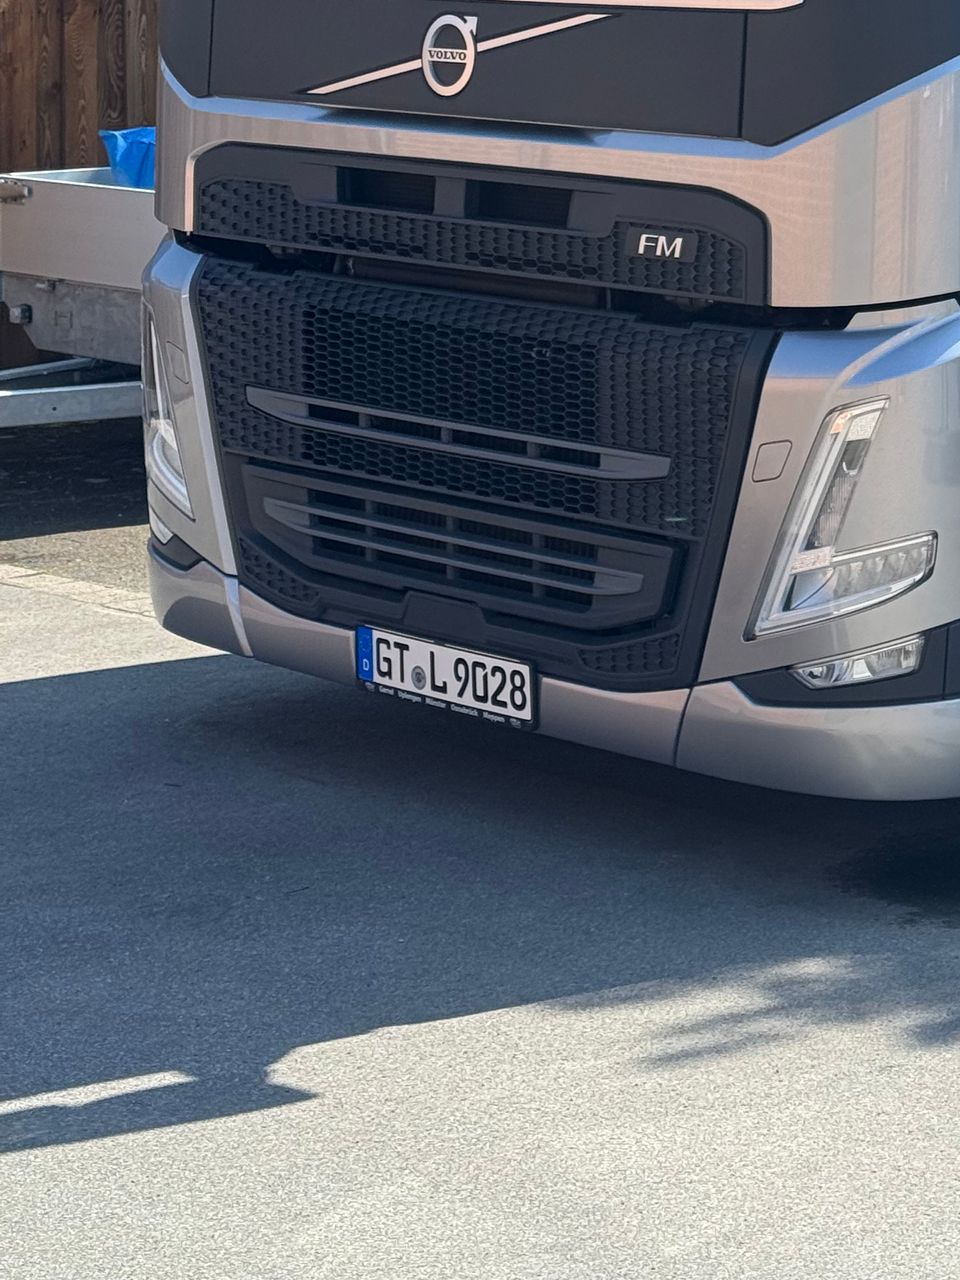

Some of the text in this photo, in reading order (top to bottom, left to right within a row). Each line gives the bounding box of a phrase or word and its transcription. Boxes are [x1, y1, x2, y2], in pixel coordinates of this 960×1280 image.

[428, 49, 467, 61] VOLVO
[638, 233, 683, 259] FM
[363, 637, 527, 711] D GT L 9028
